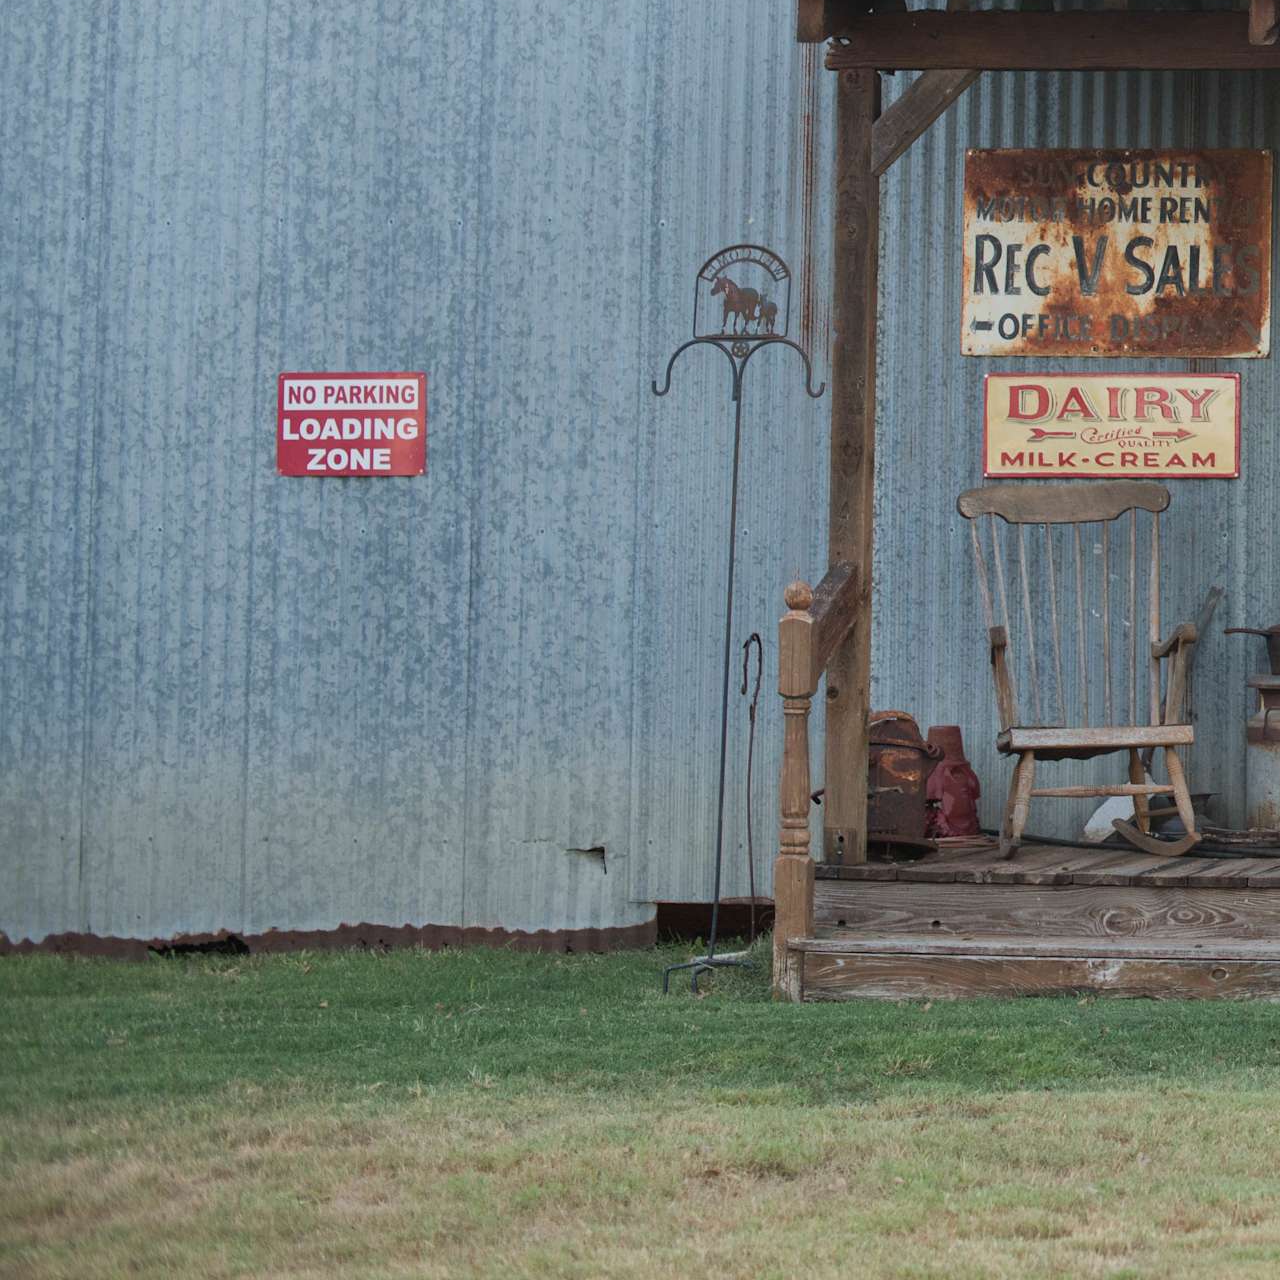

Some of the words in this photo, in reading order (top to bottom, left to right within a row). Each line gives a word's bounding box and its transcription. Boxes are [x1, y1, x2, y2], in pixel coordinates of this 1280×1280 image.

[1086, 160, 1224, 189] COUNTR
[1076, 197, 1152, 223] HOME
[973, 234, 1051, 297] REC
[1072, 235, 1110, 297] V
[1123, 235, 1260, 298] SALES
[998, 312, 1092, 341] OFFICE
[288, 385, 316, 404] NO
[323, 385, 415, 404] PARKING
[1008, 384, 1217, 422] DAIRY
[282, 417, 418, 440] LOADING
[1080, 427, 1143, 444] Certified
[1118, 439, 1172, 448] QUALITY
[307, 448, 391, 470] ZONE
